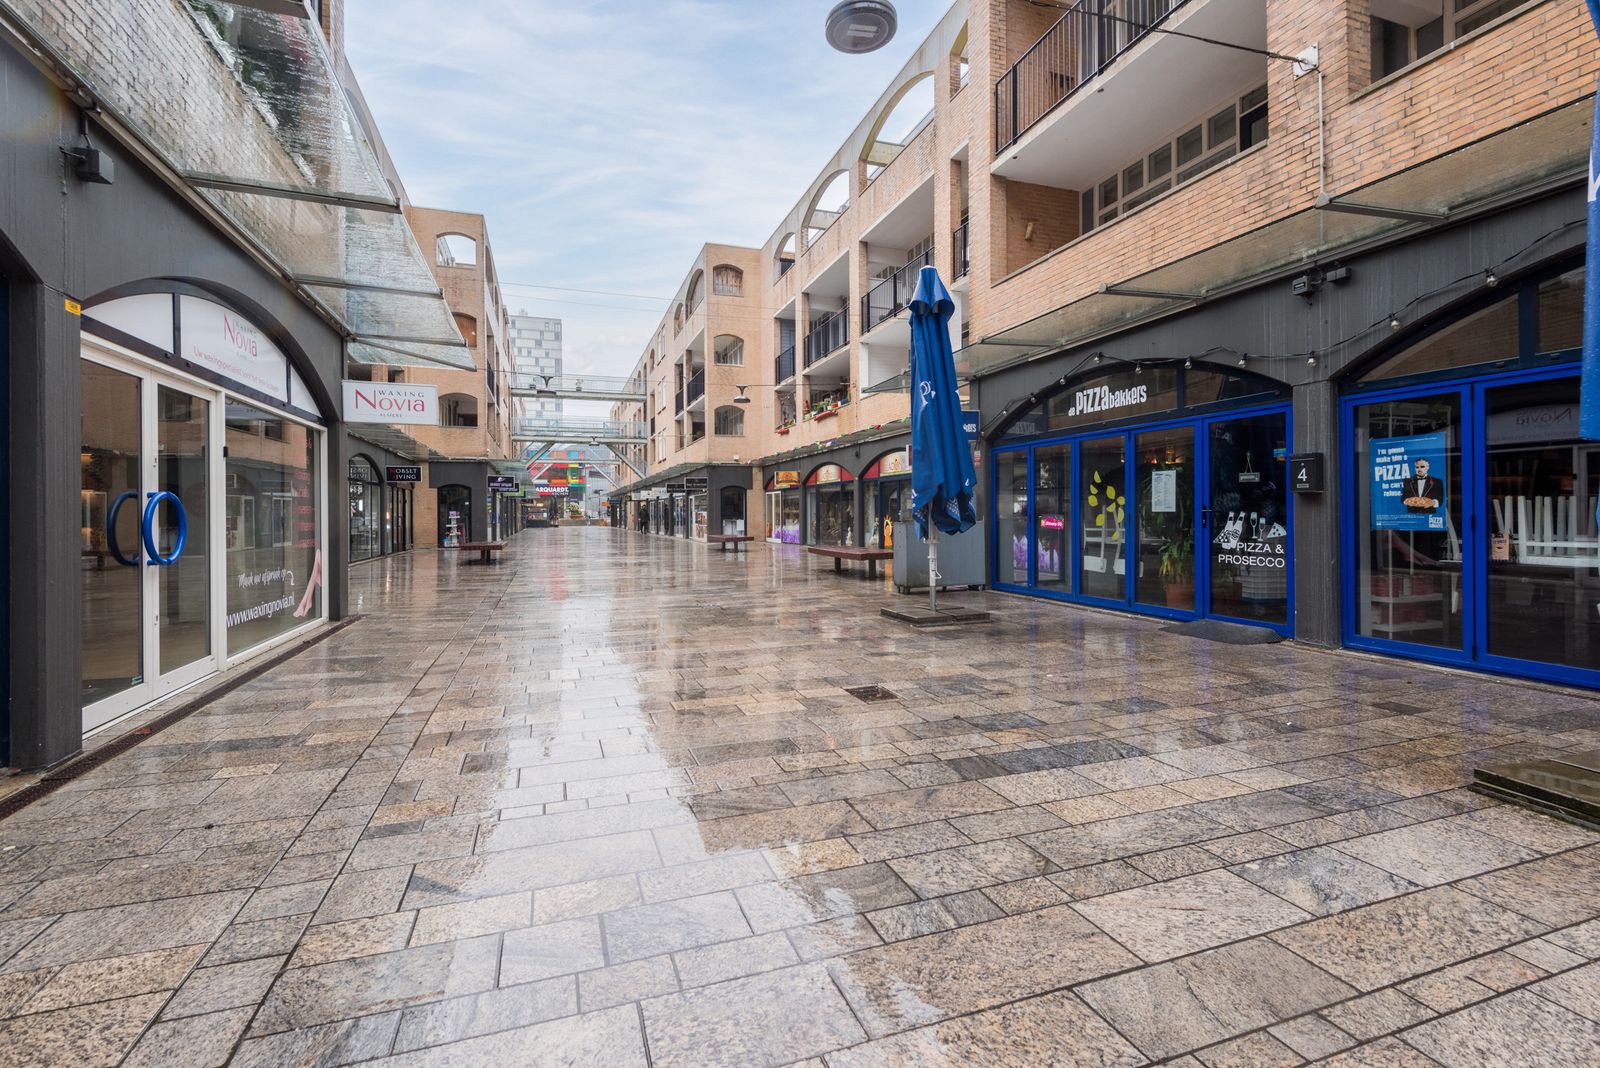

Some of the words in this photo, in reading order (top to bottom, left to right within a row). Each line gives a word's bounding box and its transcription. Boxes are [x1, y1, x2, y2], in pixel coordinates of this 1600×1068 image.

[378, 390, 425, 398] WAXING
[1297, 467, 1308, 481] 4
[1236, 542, 1272, 553] PIZZA
[1275, 544, 1285, 554] &
[1218, 554, 1285, 568] PROSECCO
